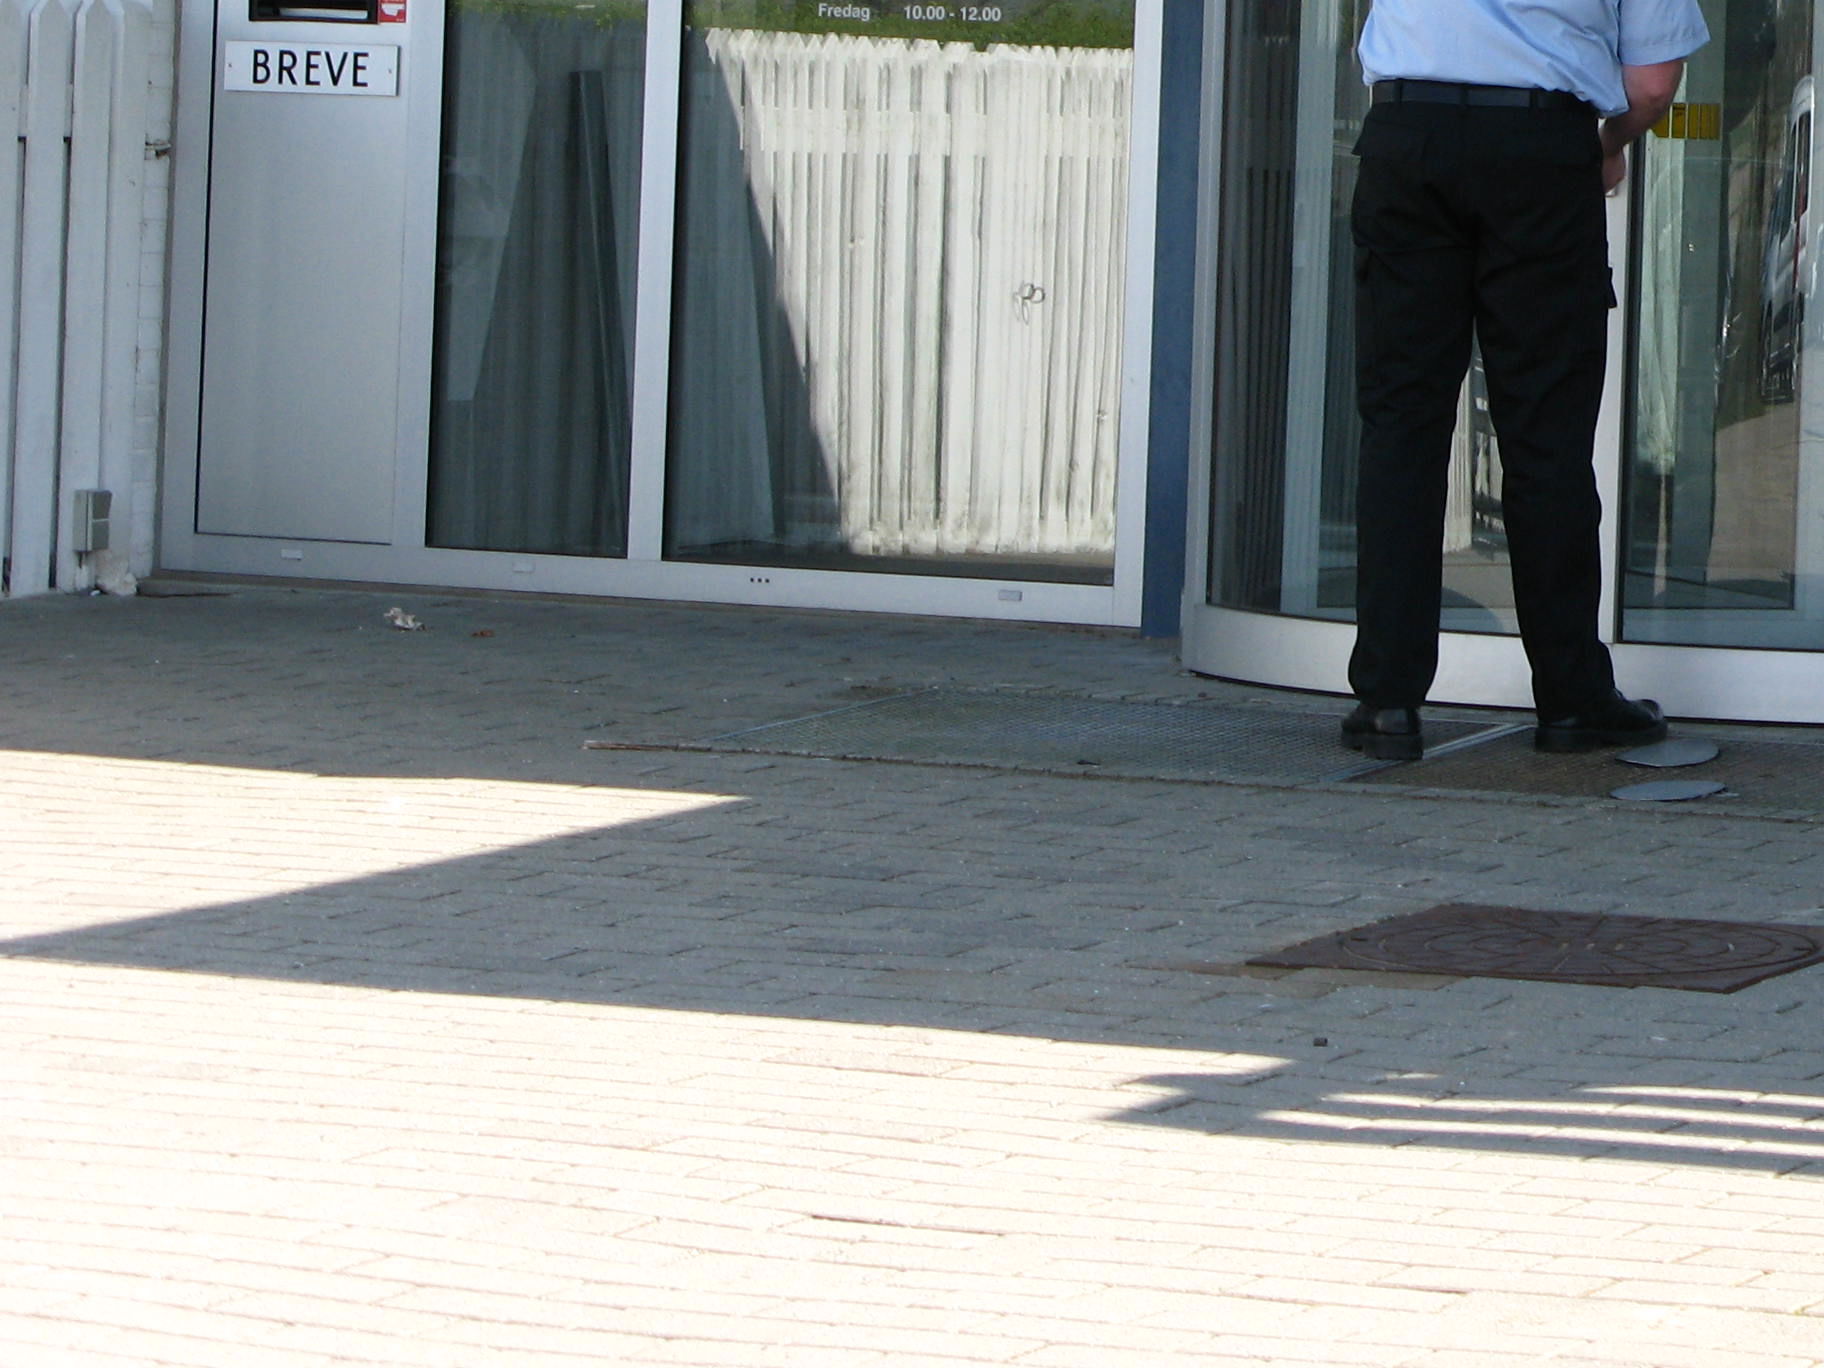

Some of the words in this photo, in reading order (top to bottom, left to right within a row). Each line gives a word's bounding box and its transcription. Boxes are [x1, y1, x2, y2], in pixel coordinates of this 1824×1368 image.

[817, 3, 871, 22] Fredag
[904, 5, 945, 20] 10.00
[960, 6, 1002, 21] 12.00
[252, 48, 370, 88] BREVE
